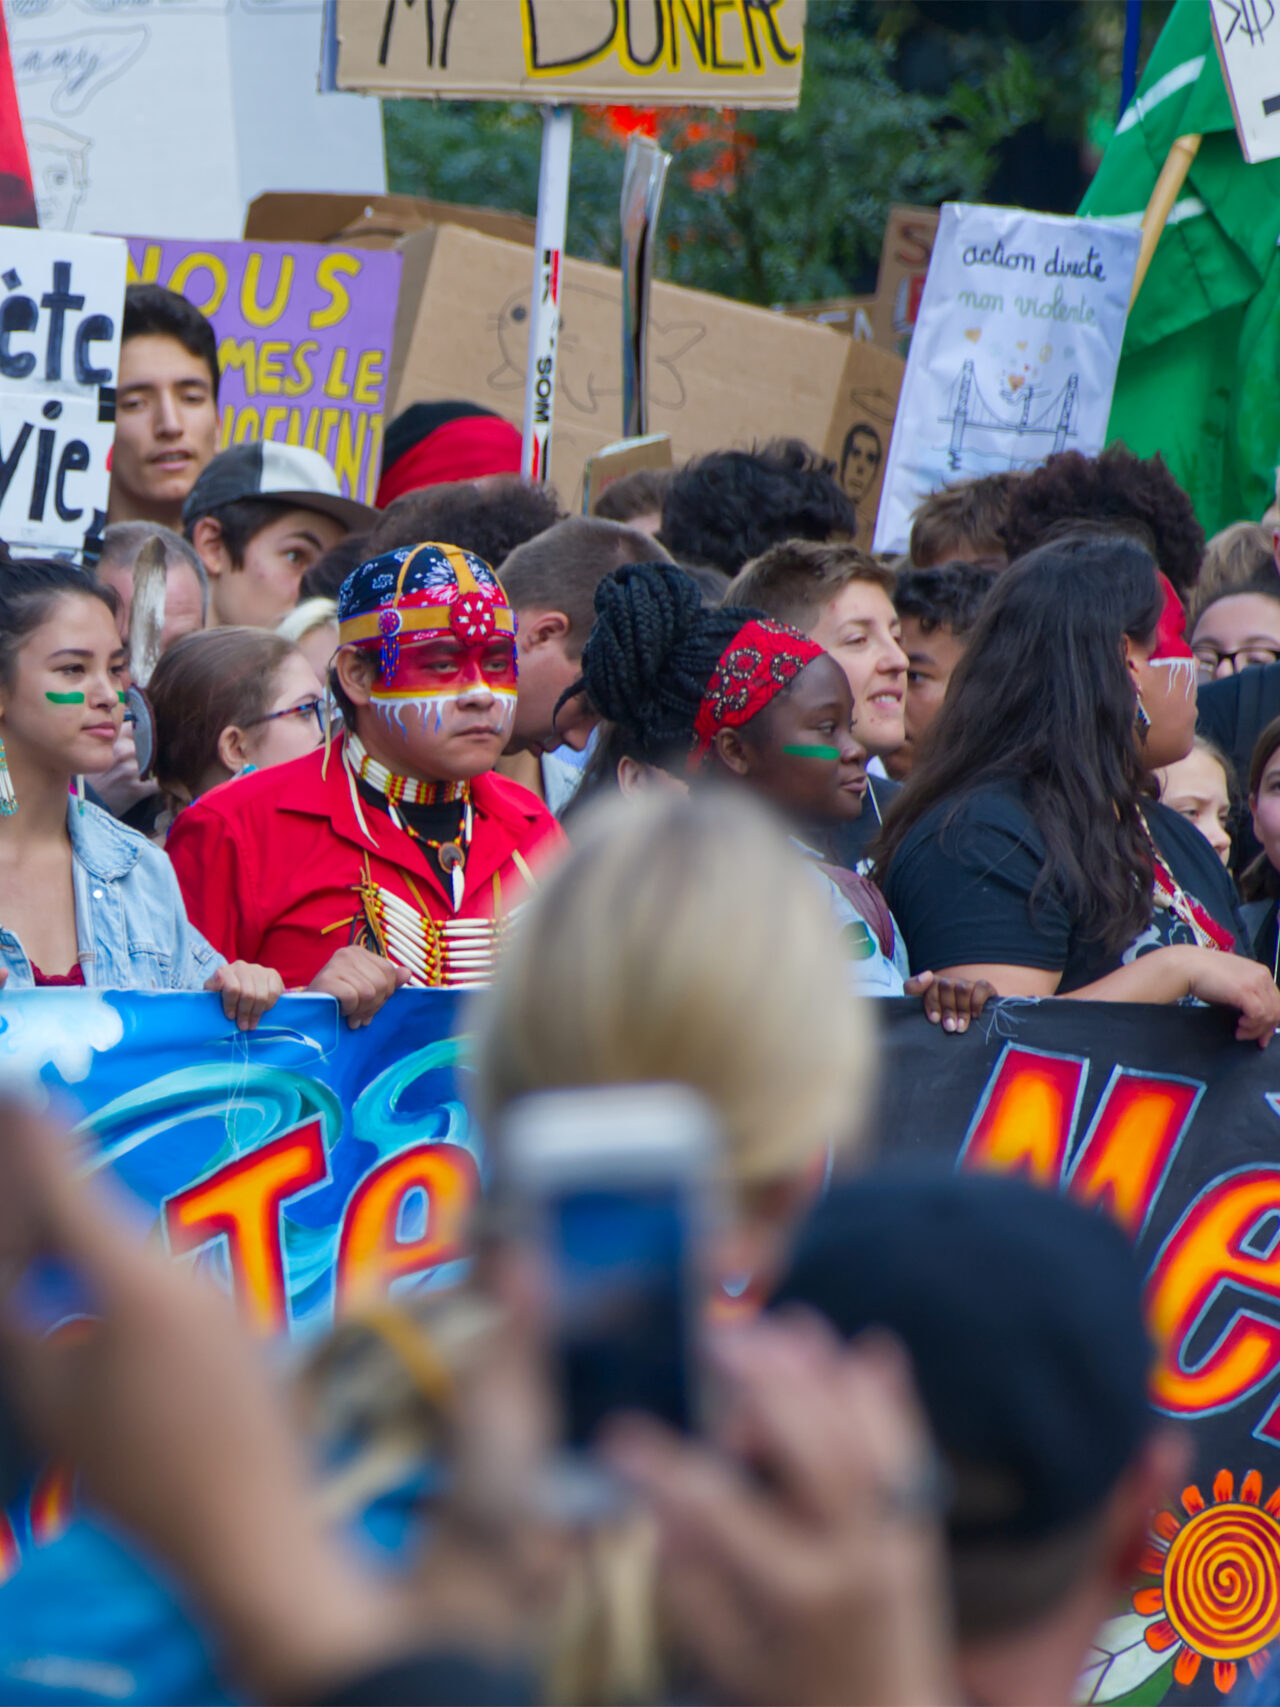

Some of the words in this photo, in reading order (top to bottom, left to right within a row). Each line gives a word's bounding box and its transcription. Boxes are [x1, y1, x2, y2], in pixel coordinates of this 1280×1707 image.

[962, 240, 1035, 273] action
[1044, 246, 1106, 282] directe
[958, 290, 1004, 313] non
[1013, 284, 1097, 327] violente
[323, 347, 385, 405] LE
